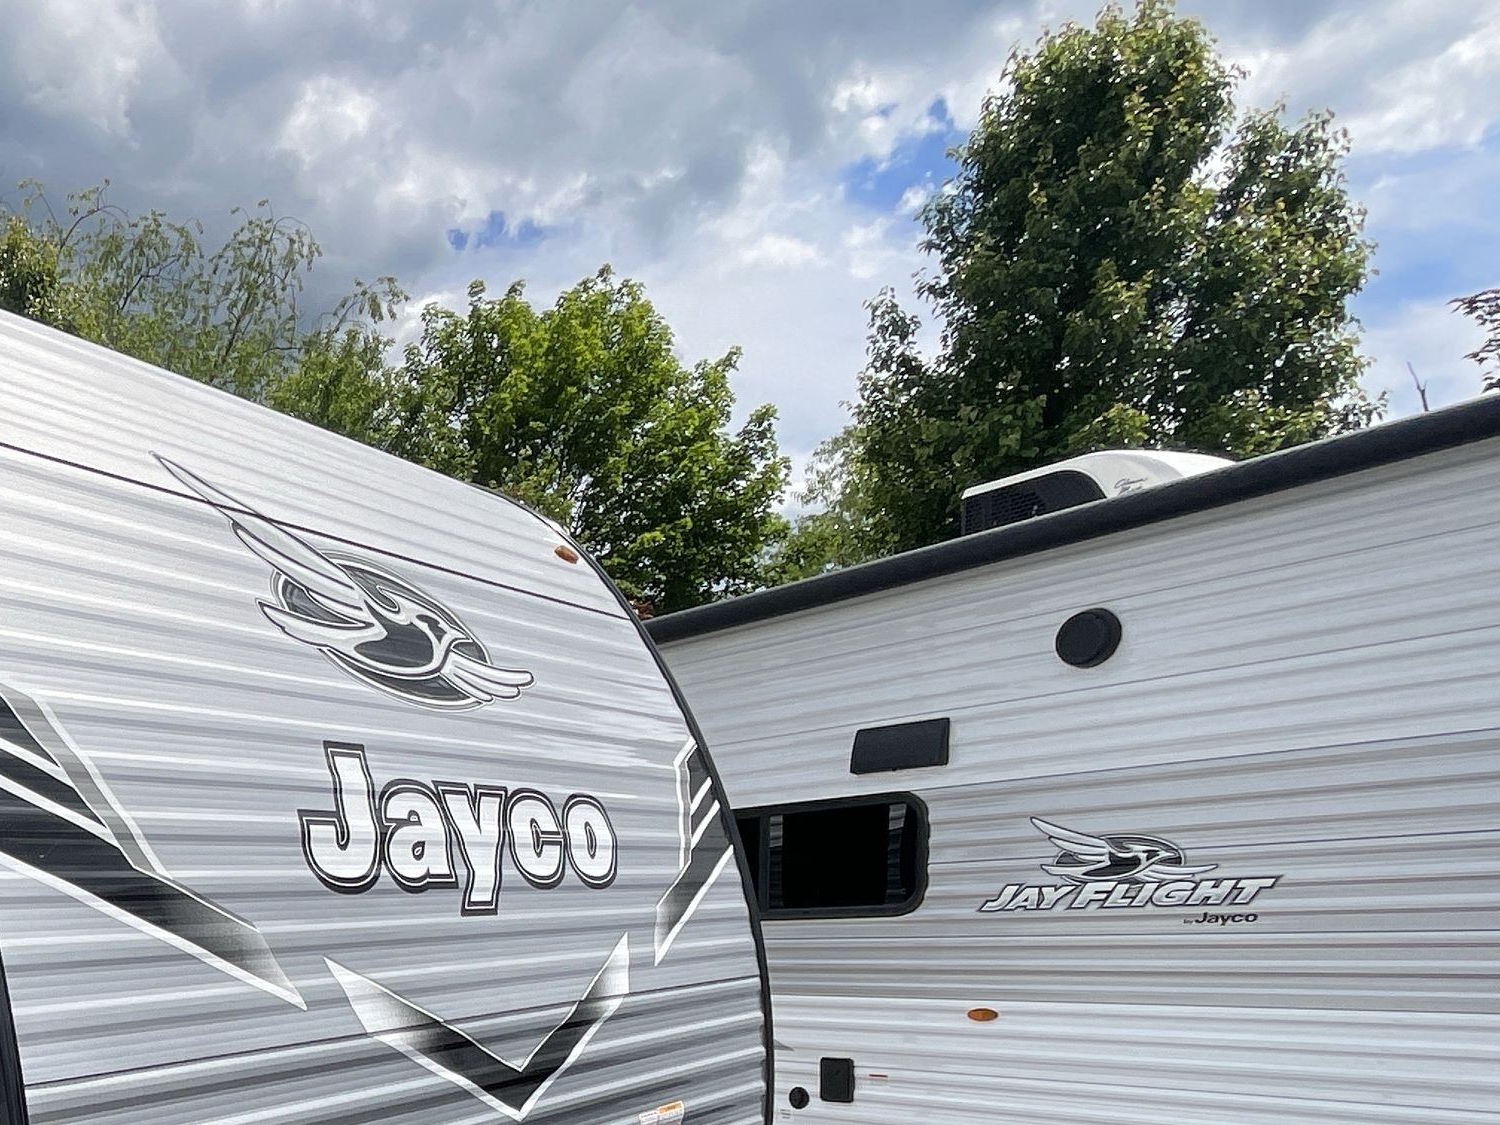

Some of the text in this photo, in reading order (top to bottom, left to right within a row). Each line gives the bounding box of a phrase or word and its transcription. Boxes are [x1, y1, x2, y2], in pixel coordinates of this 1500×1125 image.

[297, 740, 617, 916] Jayco
[977, 875, 1284, 912] JAY FLIGHT
[1195, 911, 1258, 926] Jayco
